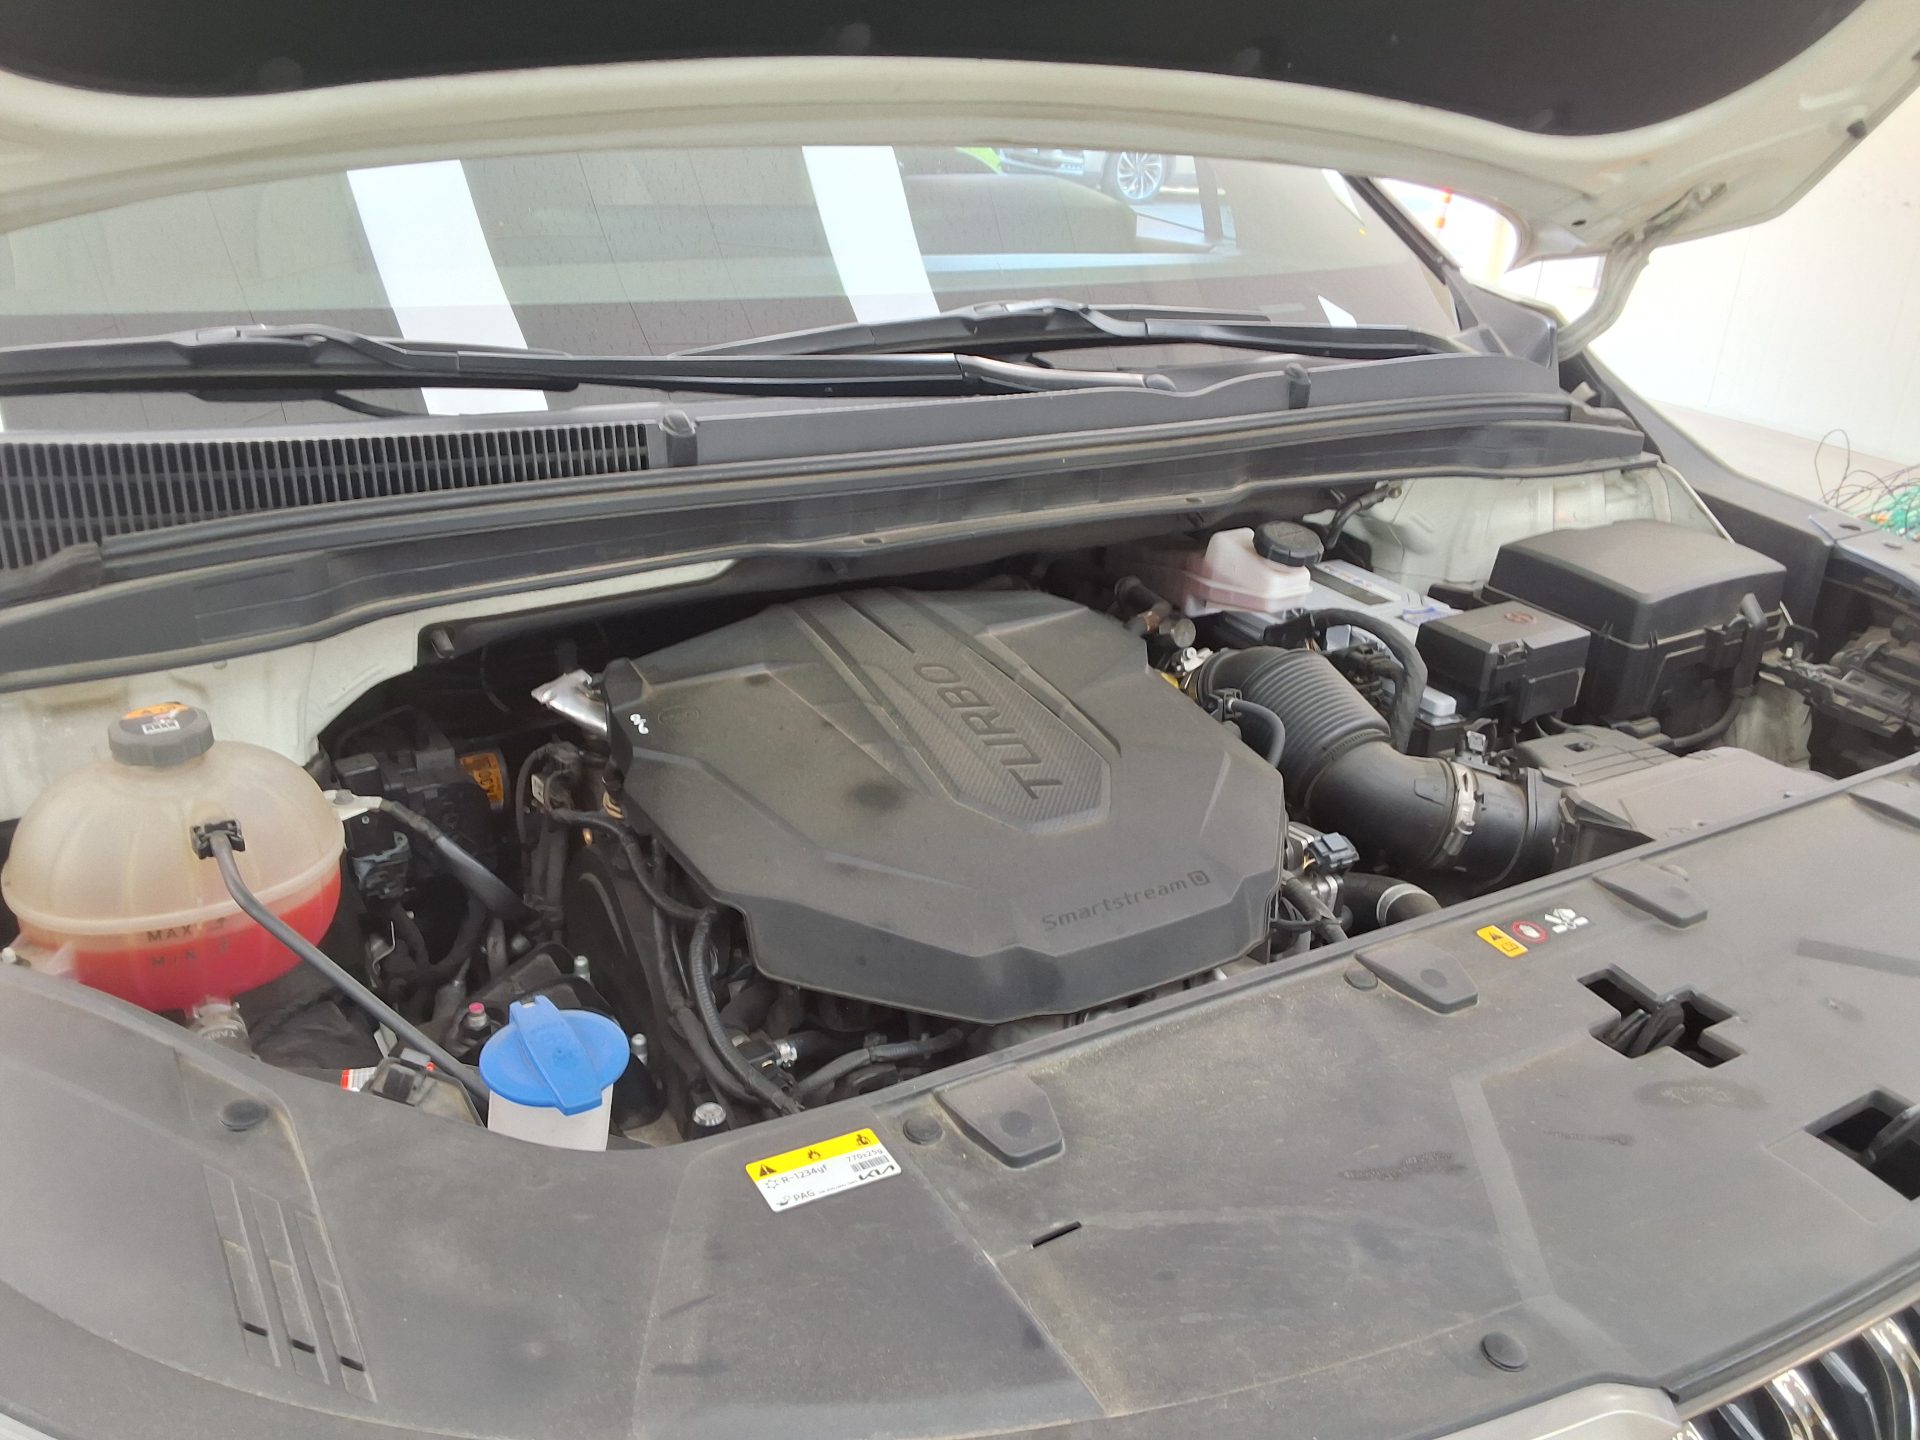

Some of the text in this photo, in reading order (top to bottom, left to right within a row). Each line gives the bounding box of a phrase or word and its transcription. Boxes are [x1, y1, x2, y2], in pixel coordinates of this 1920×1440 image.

[913, 662, 1063, 799] TURBO
[1041, 879, 1187, 931] Smartstream
[146, 924, 192, 943] MAX
[781, 1164, 828, 1184] R-1234yf
[858, 1165, 895, 1181] KIA
[793, 1190, 815, 1201] PAG
